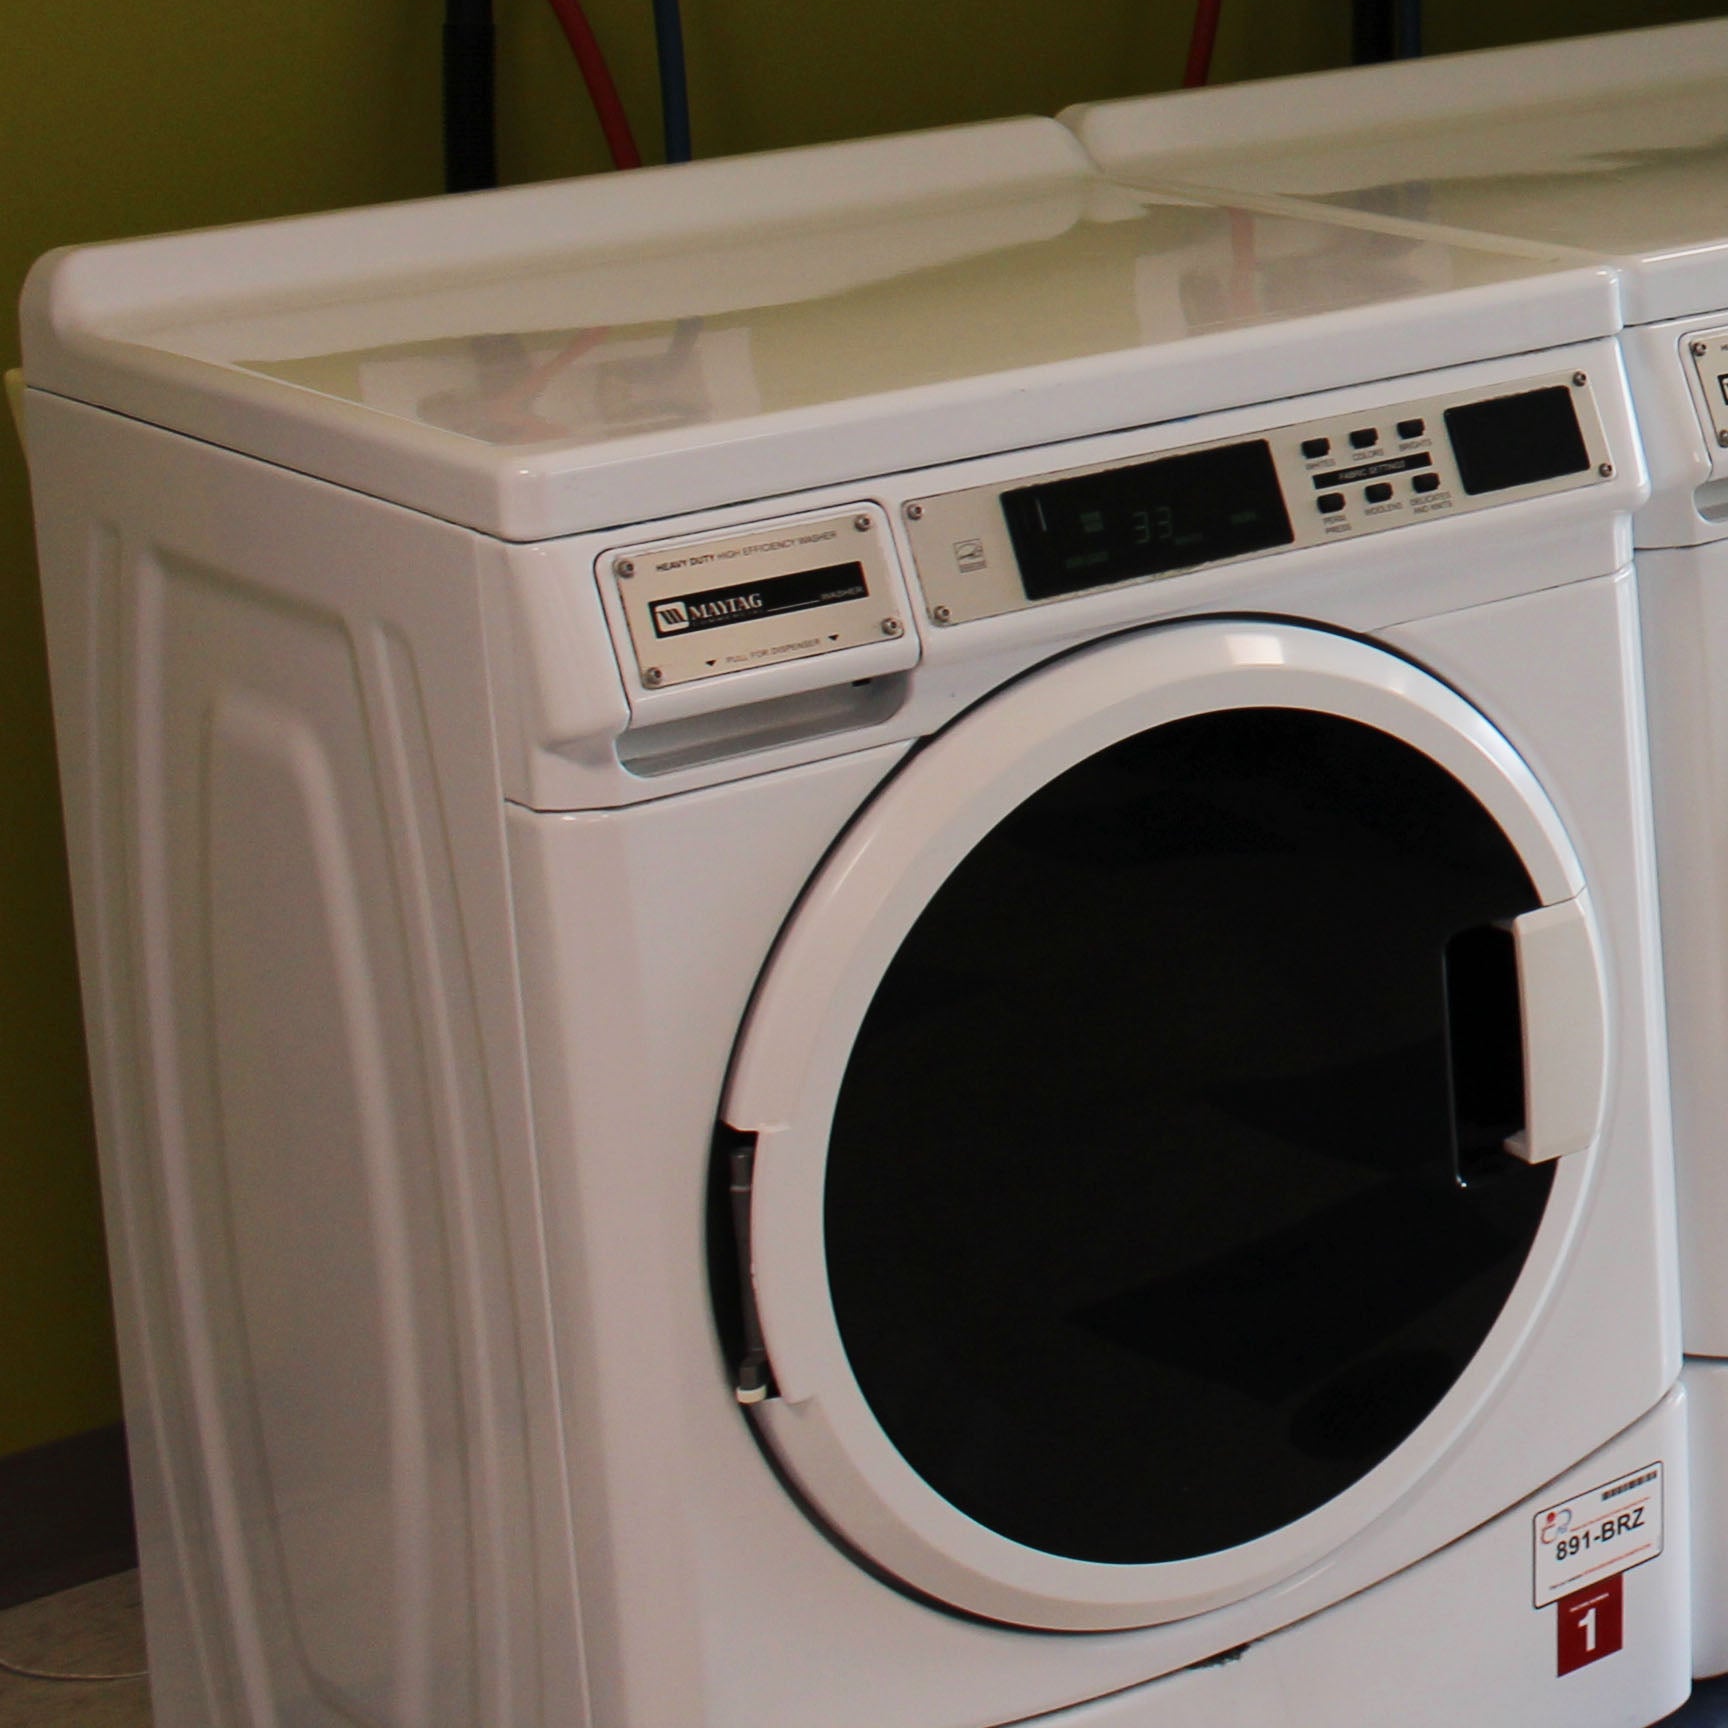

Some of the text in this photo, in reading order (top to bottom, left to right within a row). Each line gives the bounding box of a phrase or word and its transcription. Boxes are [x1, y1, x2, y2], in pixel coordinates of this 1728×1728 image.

[1132, 506, 1174, 544] 33
[655, 530, 837, 572] HEAVY DUTY HIGH EFFICIENCY WASHER
[687, 592, 763, 622] MAYTAG
[1556, 1505, 1646, 1561] 891-BRZ
[1577, 1607, 1596, 1652] 1
